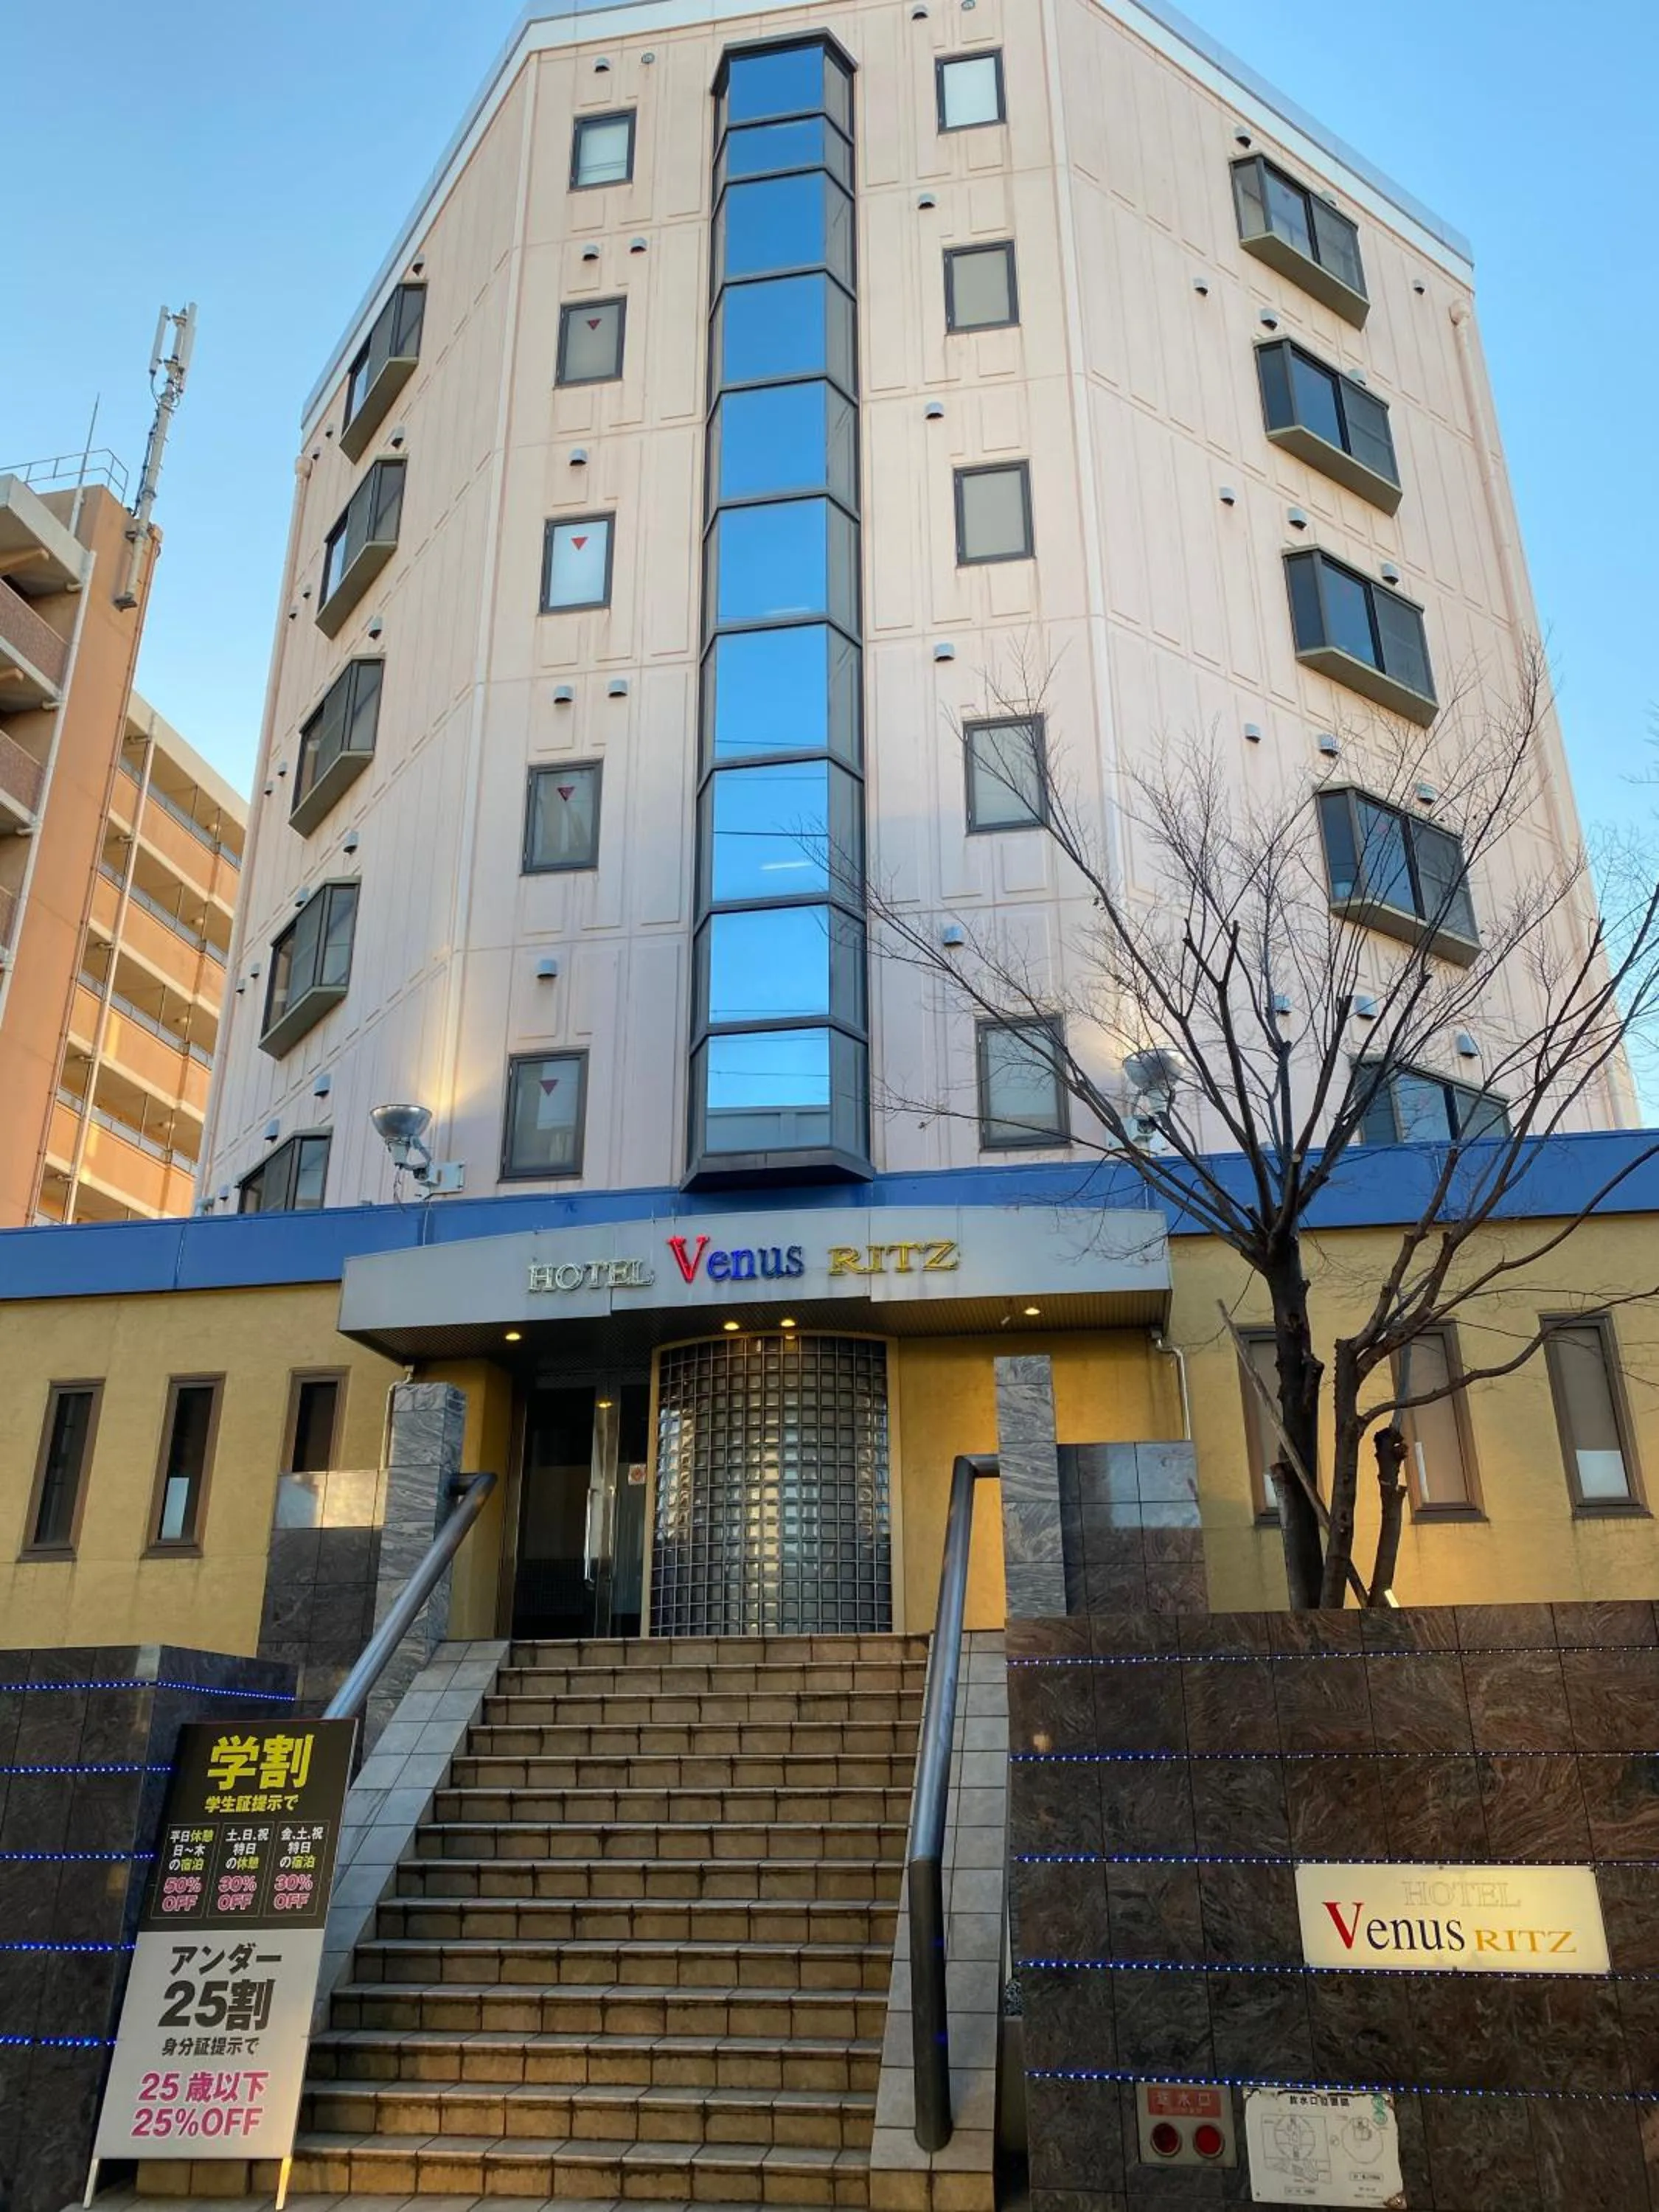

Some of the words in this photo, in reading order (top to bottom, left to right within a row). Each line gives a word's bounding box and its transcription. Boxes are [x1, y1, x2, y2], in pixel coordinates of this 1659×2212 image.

[529, 1259, 655, 1293] HOTEL
[667, 1234, 804, 1284] Venus
[827, 1239, 959, 1276] RITZ
[207, 1733, 315, 1791] 学割
[204, 1794, 299, 1814] 学生証提示で
[170, 1829, 215, 1843] 平日休憩
[168, 1857, 205, 1871] の宿泊
[225, 1856, 260, 1871] の休憩
[279, 1855, 316, 1870] の宿泊
[163, 1877, 202, 1893] 50%
[218, 1875, 257, 1893] 30%
[274, 1874, 313, 1891] 30%
[218, 1893, 254, 1911] OFF
[274, 1893, 310, 1910] OFF
[1402, 1881, 1521, 1907] HOTEL
[161, 1895, 198, 1913] OFF
[1322, 1902, 1465, 1952] Venus
[1474, 1929, 1577, 1952] RITZ
[170, 1942, 282, 1976] アンダー
[157, 1978, 276, 2031] 25割
[161, 2037, 260, 2056] 身分証提示で
[131, 2107, 264, 2138] 25%OFF
